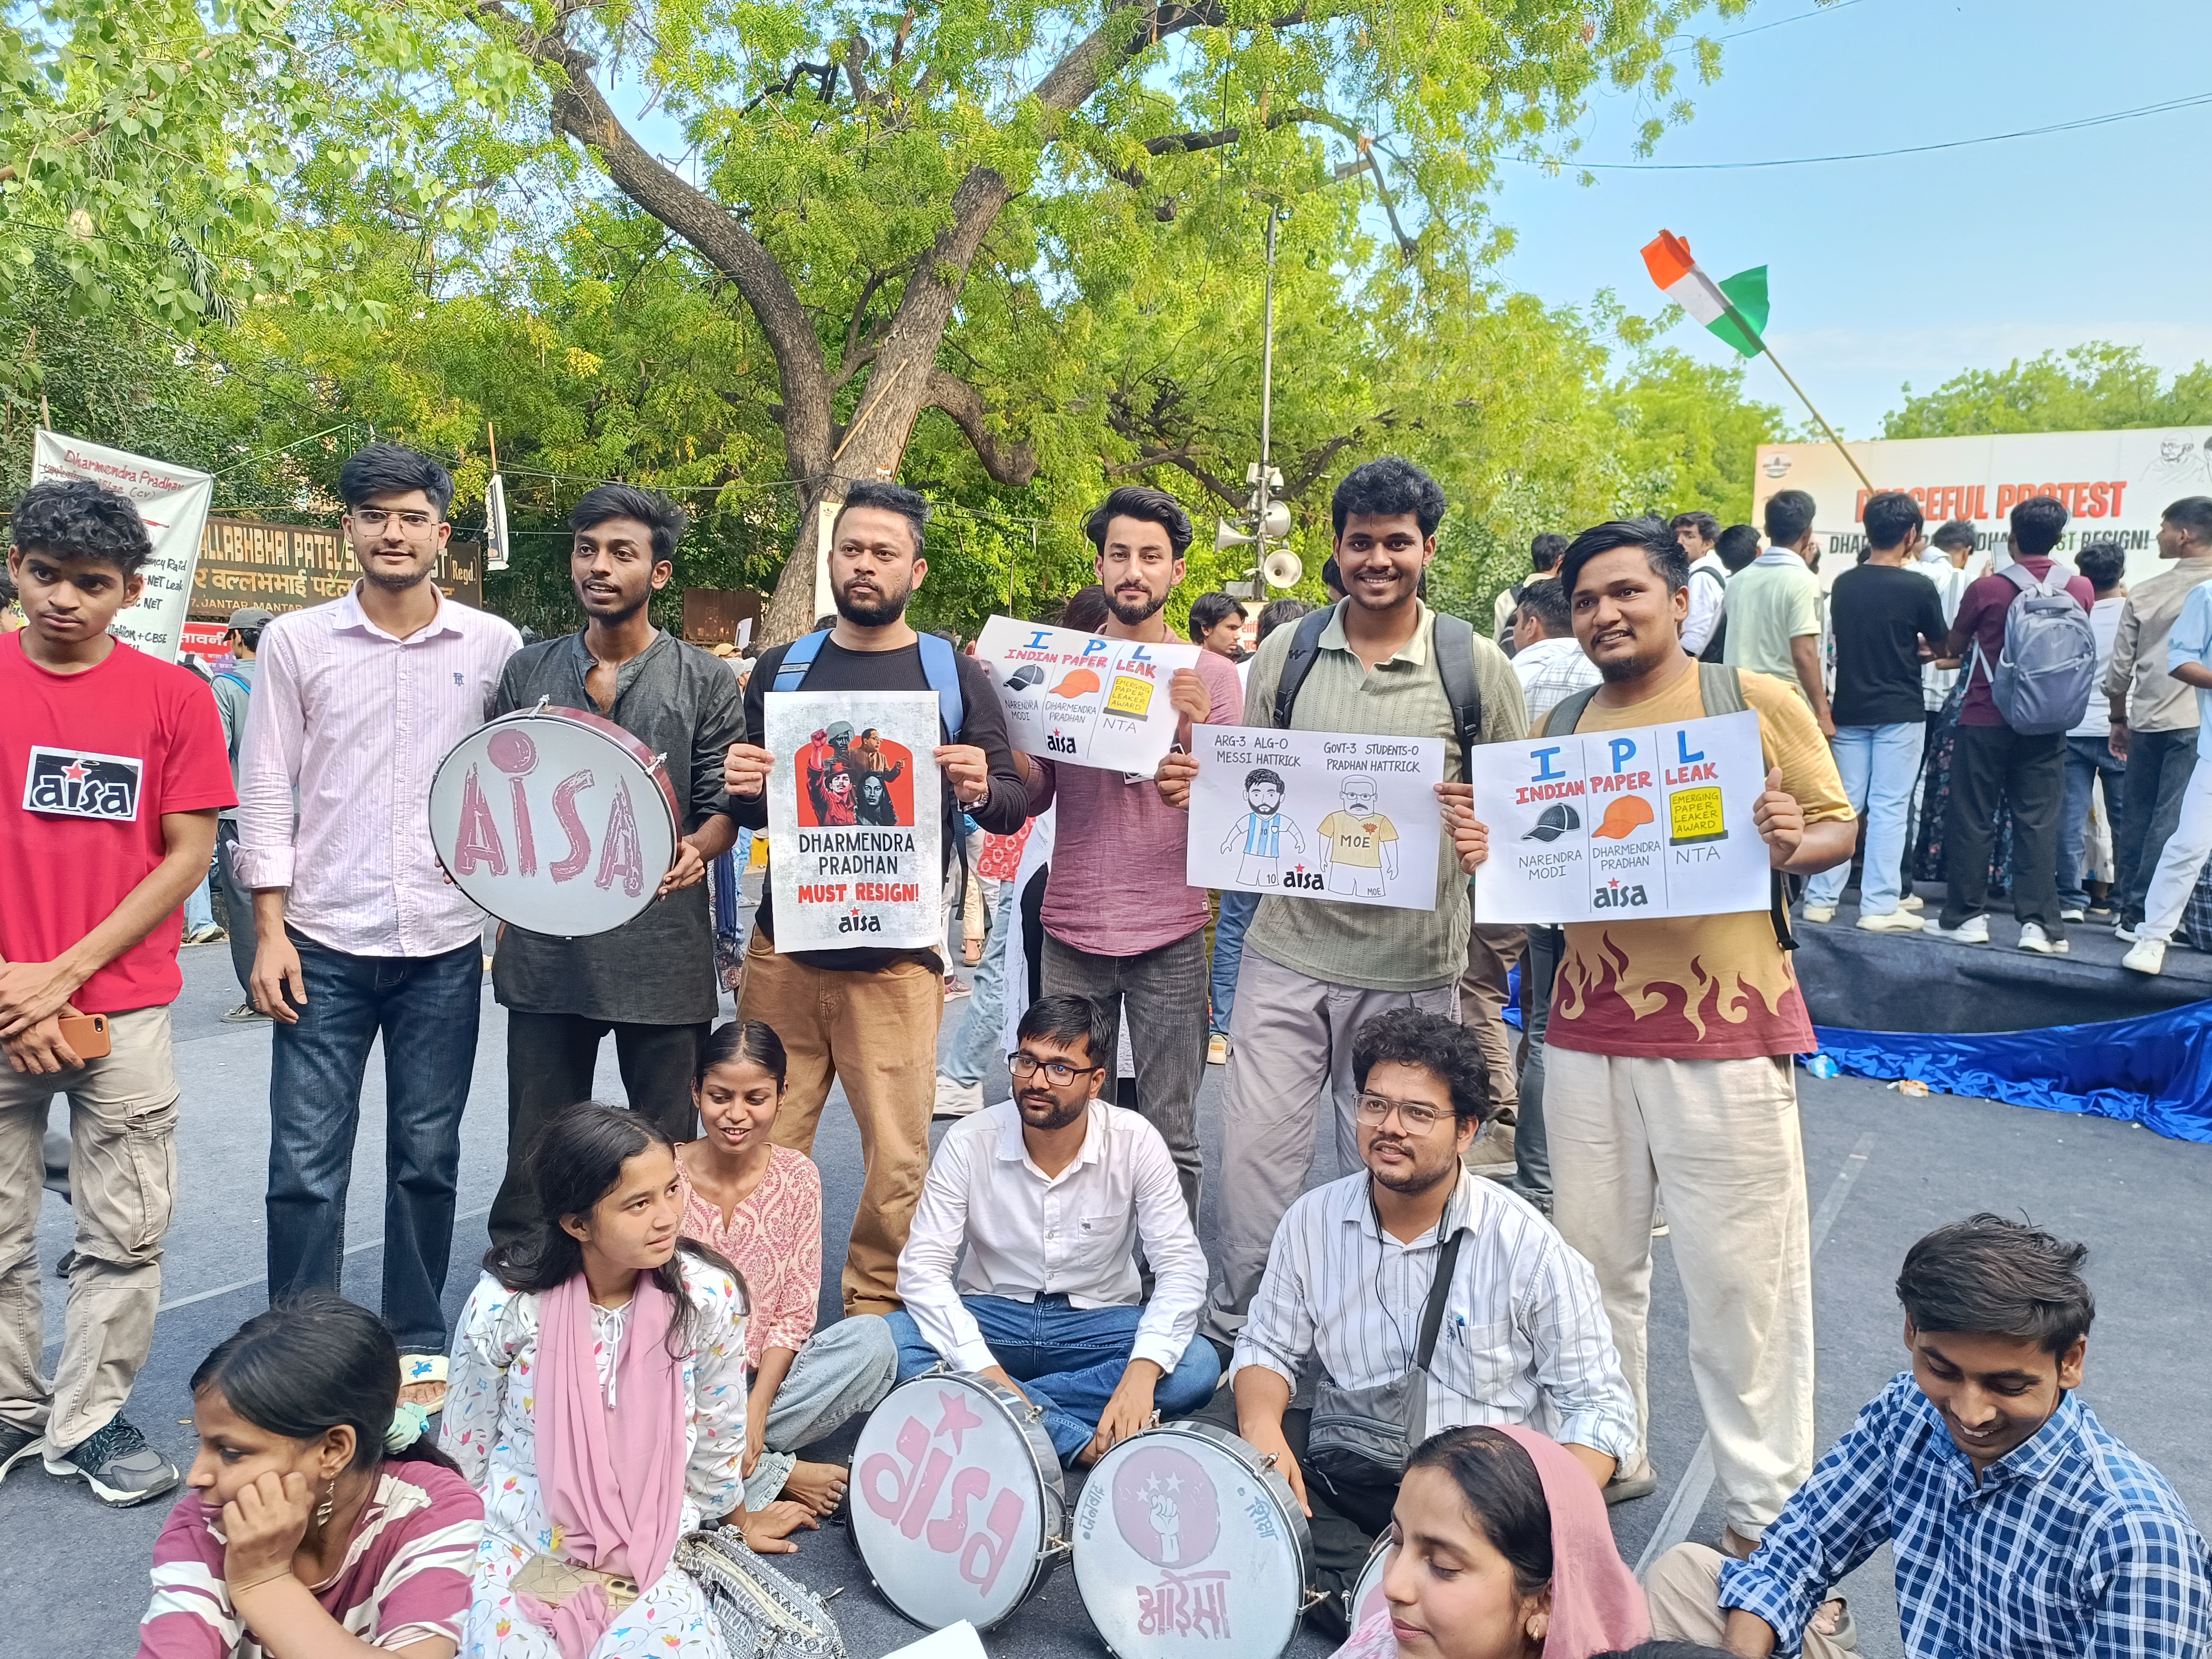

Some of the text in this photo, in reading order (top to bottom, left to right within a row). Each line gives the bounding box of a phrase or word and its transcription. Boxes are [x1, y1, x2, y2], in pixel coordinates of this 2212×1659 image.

[64, 449, 137, 482] Dharmendra
[139, 470, 184, 491] Pradhan
[294, 532, 342, 570] PATEL
[167, 558, 187, 572] Raid
[166, 580, 183, 591] Leak
[212, 569, 307, 597] वल्लभभाई
[144, 597, 163, 610] NET
[201, 598, 248, 609] JANTAR
[254, 602, 303, 612] MANTAR
[1023, 631, 1152, 660] I P L
[1005, 649, 1158, 679] INDIAN PAPER LEAK
[1115, 678, 1150, 694] EMERGING
[1115, 686, 1143, 697] PAPER
[1005, 699, 1038, 710] NARENDRA
[1111, 700, 1141, 711] AWARD
[1112, 693, 1145, 704] LEAKER
[1045, 700, 1096, 715] DHARMENDRA
[1011, 711, 1030, 721] MODI
[1049, 712, 1085, 723] PRADHAN
[1103, 718, 1136, 734] NTA
[1047, 728, 1076, 754] aisa
[1214, 735, 1246, 747] ARG-3
[1324, 742, 1356, 754] GOVT-3
[1217, 750, 1301, 767] MESSI HATTRICK
[1531, 730, 1704, 782] I P L
[1327, 758, 1420, 773] PRADHAN HATTRICK
[32, 760, 131, 816] aisa
[1516, 762, 1719, 804] INDIAN PAPER LEAK
[1672, 792, 1719, 805] EMERGING
[1675, 801, 1714, 814] PAPER
[1674, 810, 1718, 823] LEAKER
[1261, 828, 1268, 836] 10
[1676, 820, 1715, 833] AWARD
[799, 833, 915, 853] DHARMENDRA
[1341, 834, 1370, 848] MOE
[1593, 841, 1661, 859] DHARMENDRA
[1676, 845, 1721, 865] NTA
[819, 855, 897, 875] PRADHAN
[1519, 850, 1583, 869] NARENDRA
[1601, 856, 1649, 871] PRADHAN
[1266, 873, 1276, 884] 10
[1283, 863, 1324, 890] aisa
[1529, 866, 1566, 880] MODI
[798, 883, 919, 903] MUST RESIGN!
[1367, 887, 1381, 896] MOE
[1593, 877, 1648, 908] aisa
[839, 906, 882, 933] aisa
[1244, 1496, 1278, 1540] शिक्षा
